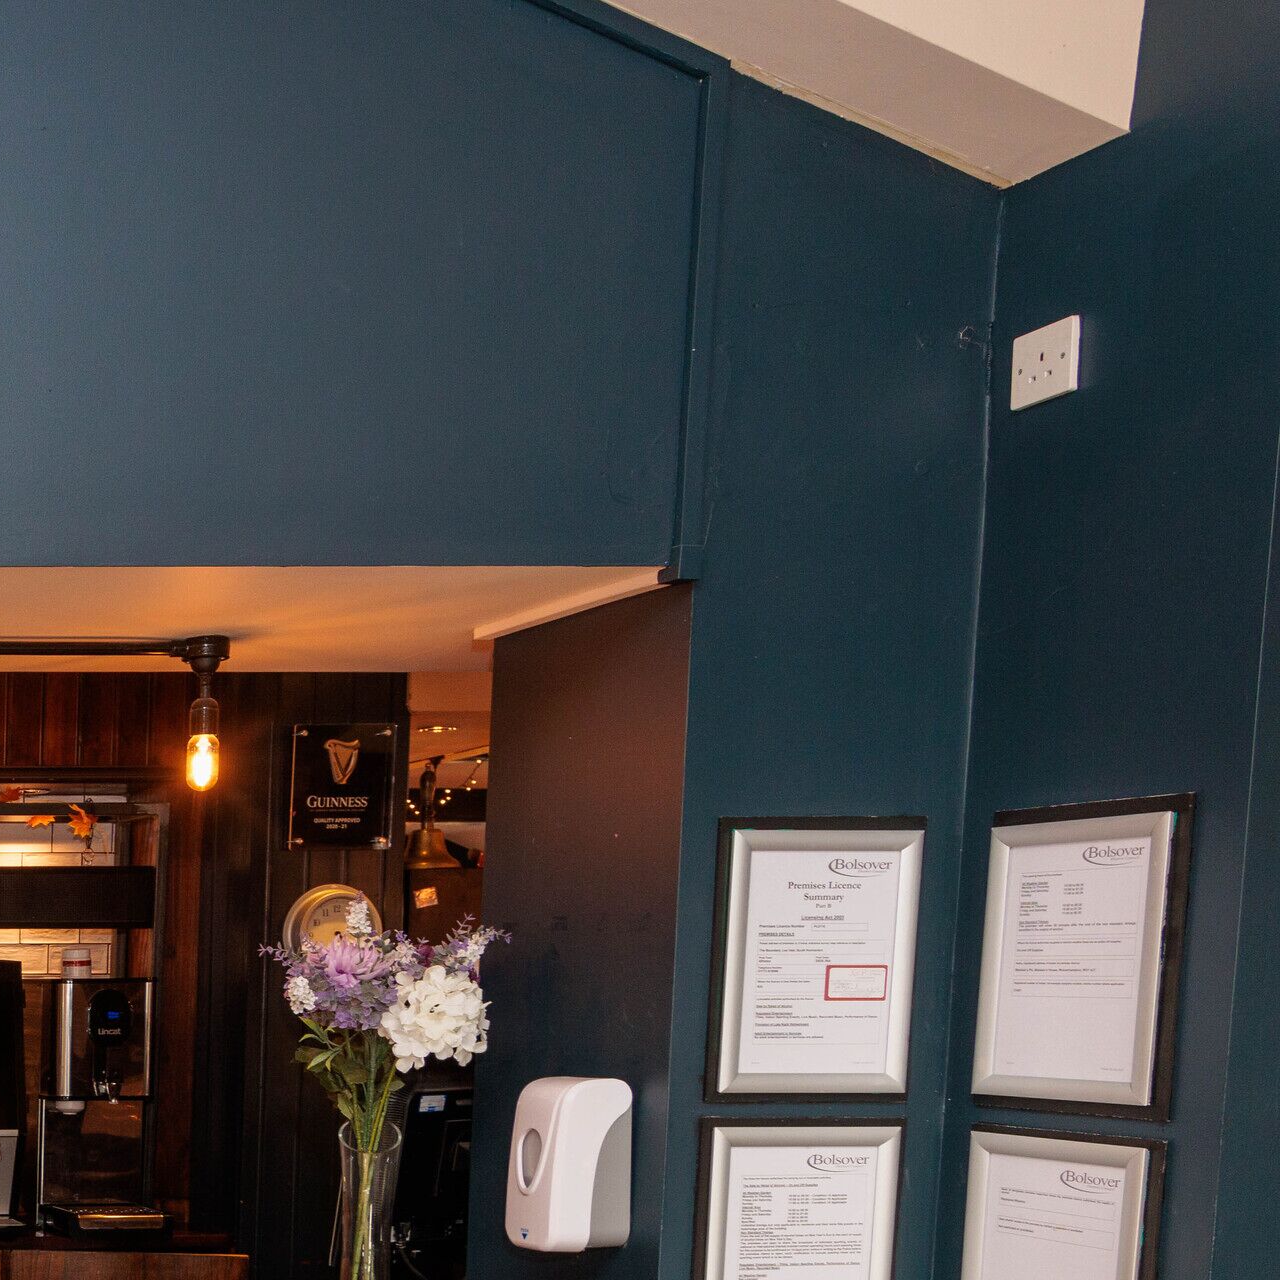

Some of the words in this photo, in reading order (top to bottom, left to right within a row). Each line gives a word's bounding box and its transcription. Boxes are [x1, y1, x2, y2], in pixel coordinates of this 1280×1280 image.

[306, 795, 368, 808] GUINNESS
[1088, 845, 1145, 859] Bolsover
[835, 858, 893, 870] Bolsover
[788, 881, 826, 889] Premises
[828, 881, 861, 889] Licence
[803, 892, 844, 902] Summary
[813, 1154, 870, 1165] Bolsover
[1066, 1170, 1121, 1188] Bolsover
